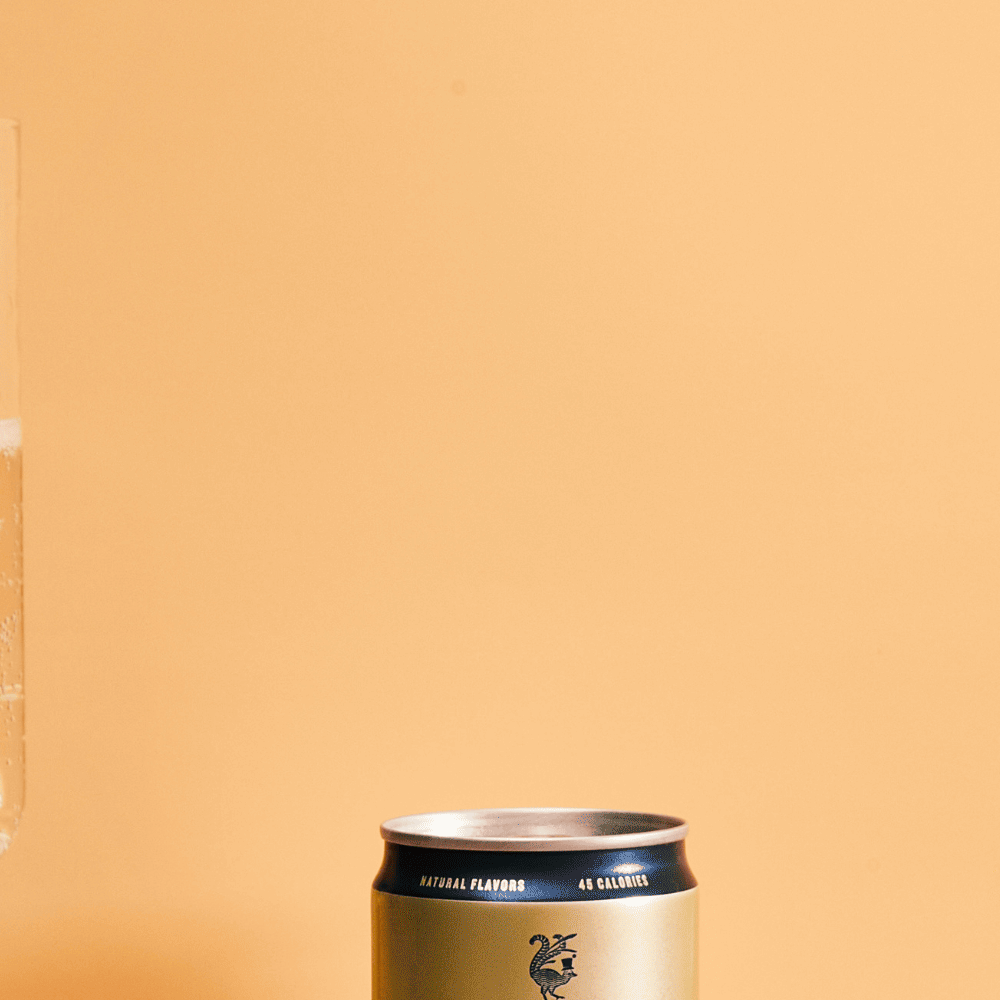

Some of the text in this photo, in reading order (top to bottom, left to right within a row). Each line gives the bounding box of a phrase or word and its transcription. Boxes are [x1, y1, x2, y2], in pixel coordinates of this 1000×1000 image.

[419, 875, 526, 892] NATURAL FLAVORS
[578, 874, 649, 891] 45 CALORIES
